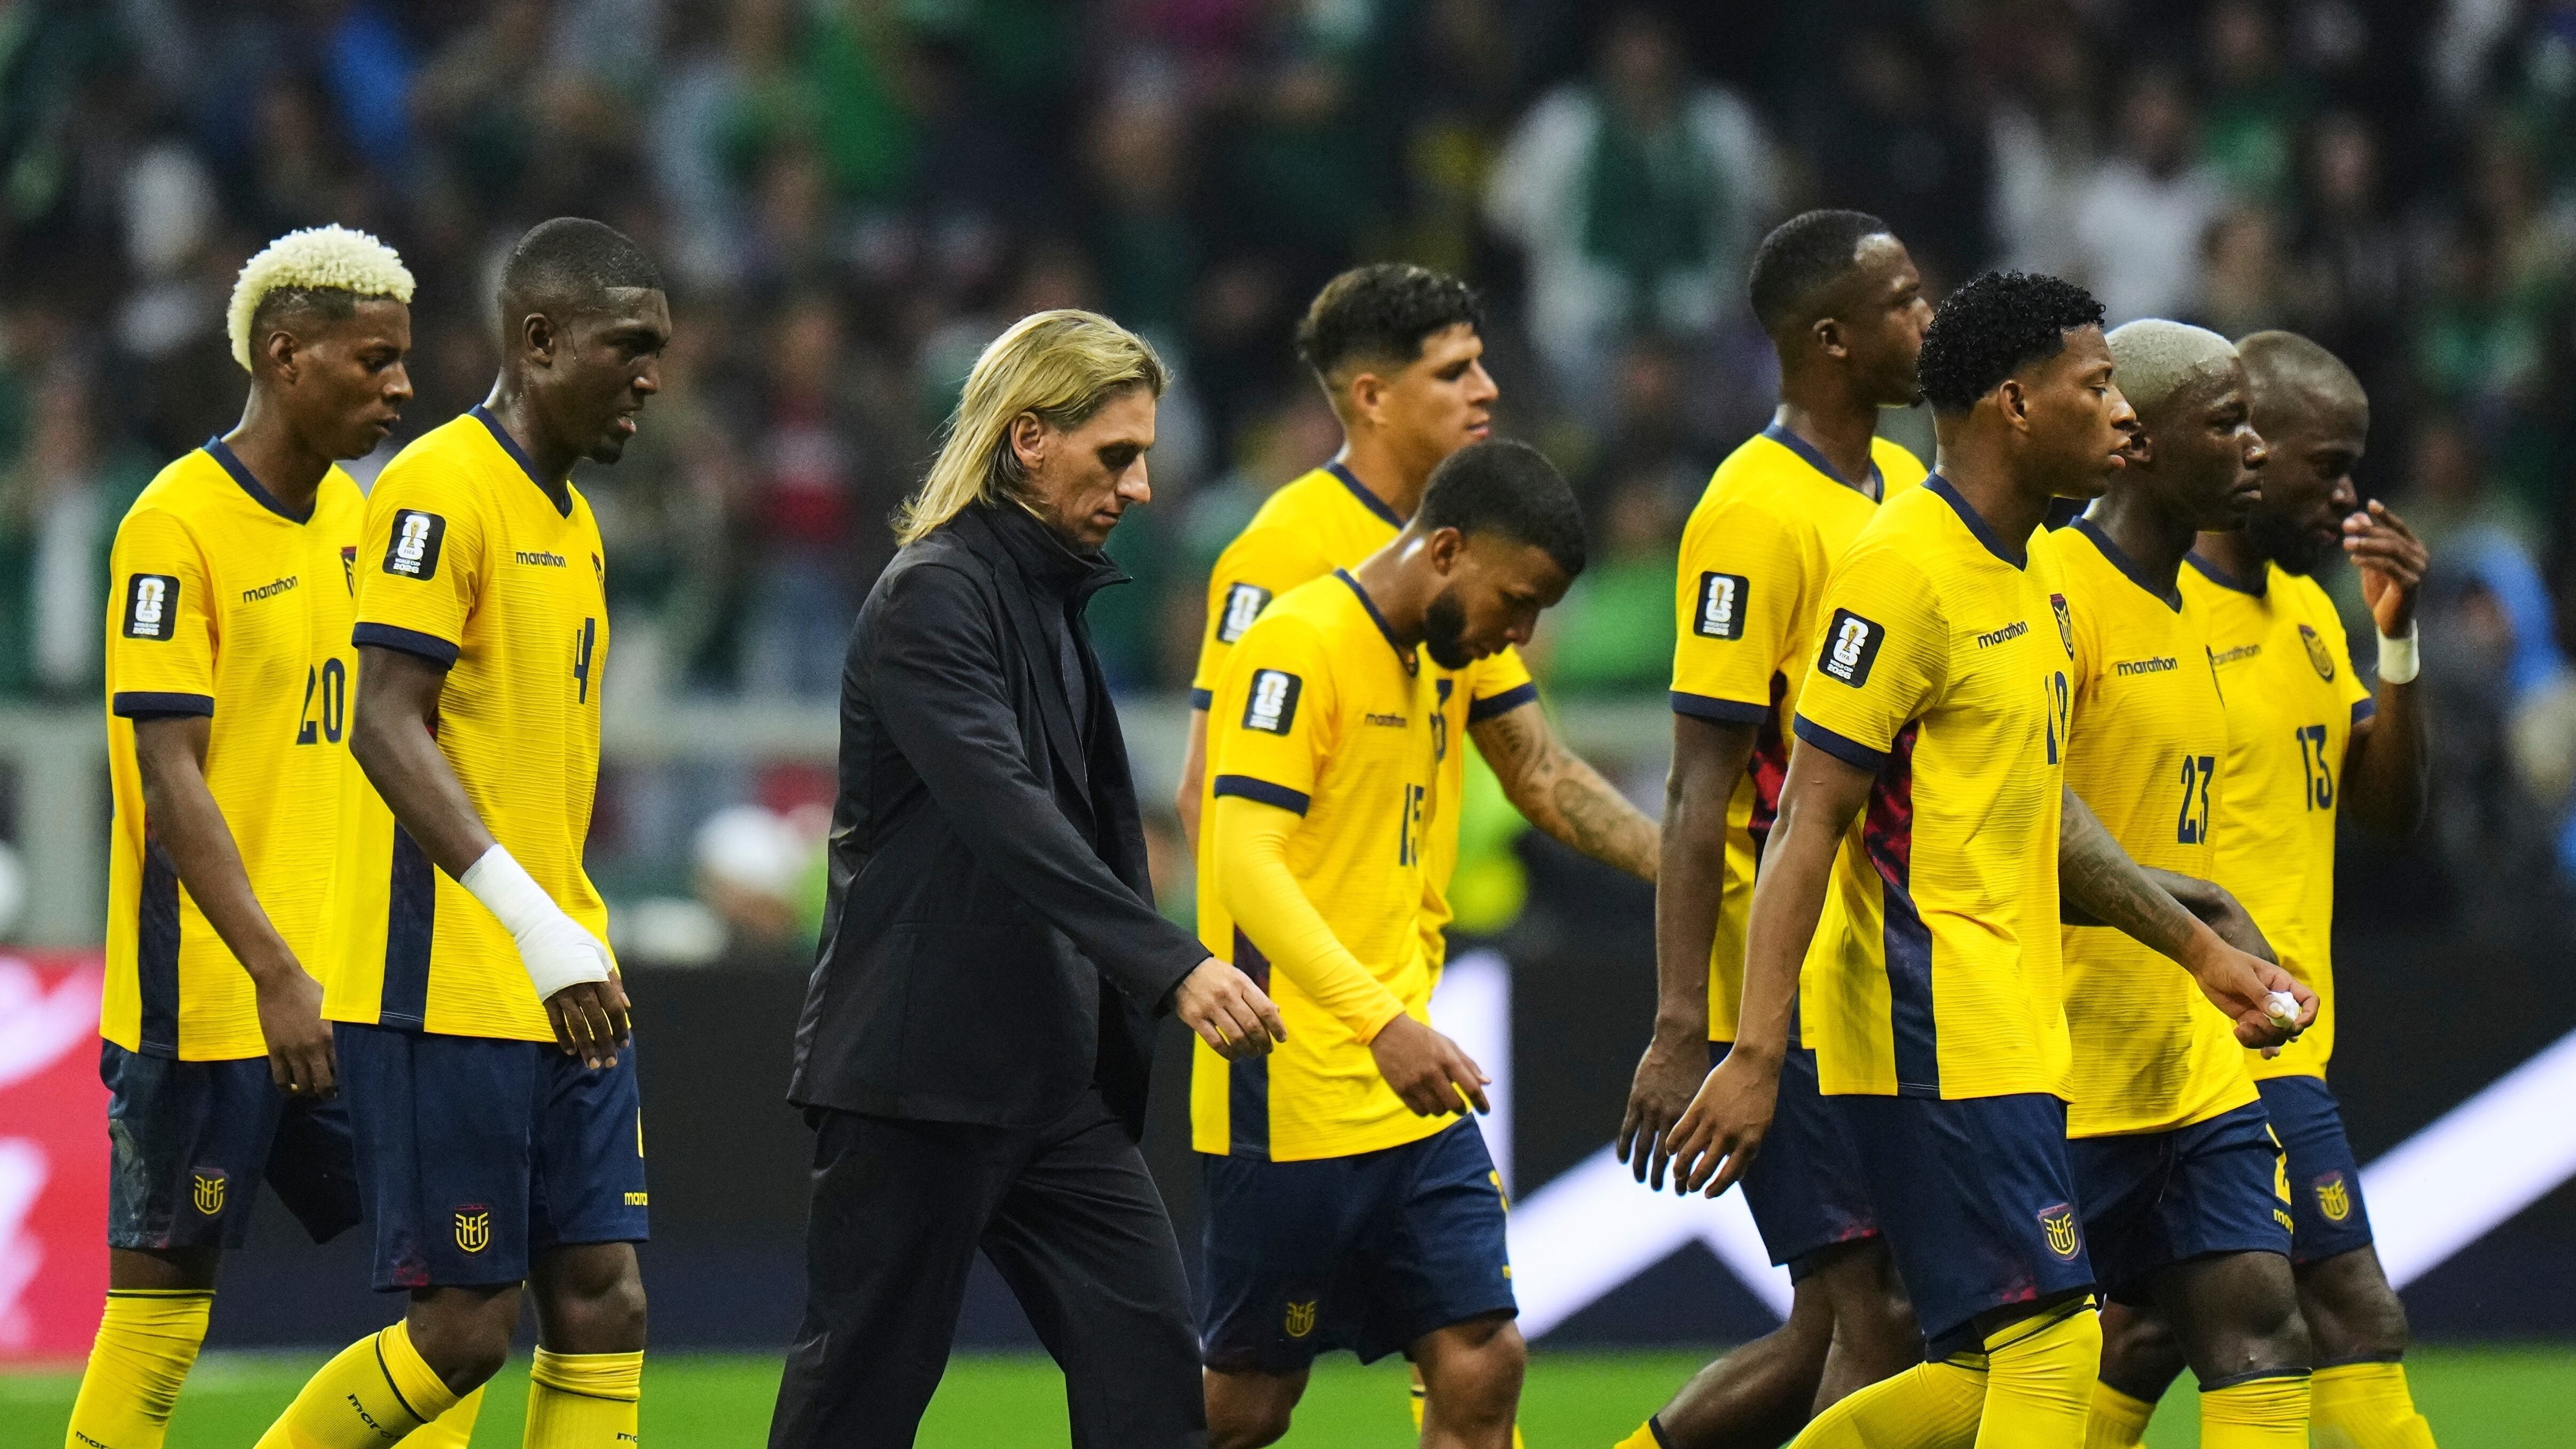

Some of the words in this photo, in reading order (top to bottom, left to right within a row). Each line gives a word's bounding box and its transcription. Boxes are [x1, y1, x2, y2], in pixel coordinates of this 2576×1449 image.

[393, 562, 419, 574] 2026
[516, 551, 566, 568] marathon
[242, 576, 298, 604] marathon
[1977, 621, 2029, 649] marathon
[574, 617, 595, 704] 4
[1830, 659, 1844, 669] WORLD
[1839, 652, 1850, 661] FIFA
[2212, 644, 2262, 666] arathon
[1827, 663, 1852, 680] 2026
[2117, 656, 2178, 677] marathon
[296, 658, 345, 745] 20
[2296, 724, 2333, 812] 13
[2178, 755, 2215, 845] 23
[624, 1192, 648, 1206] mara
